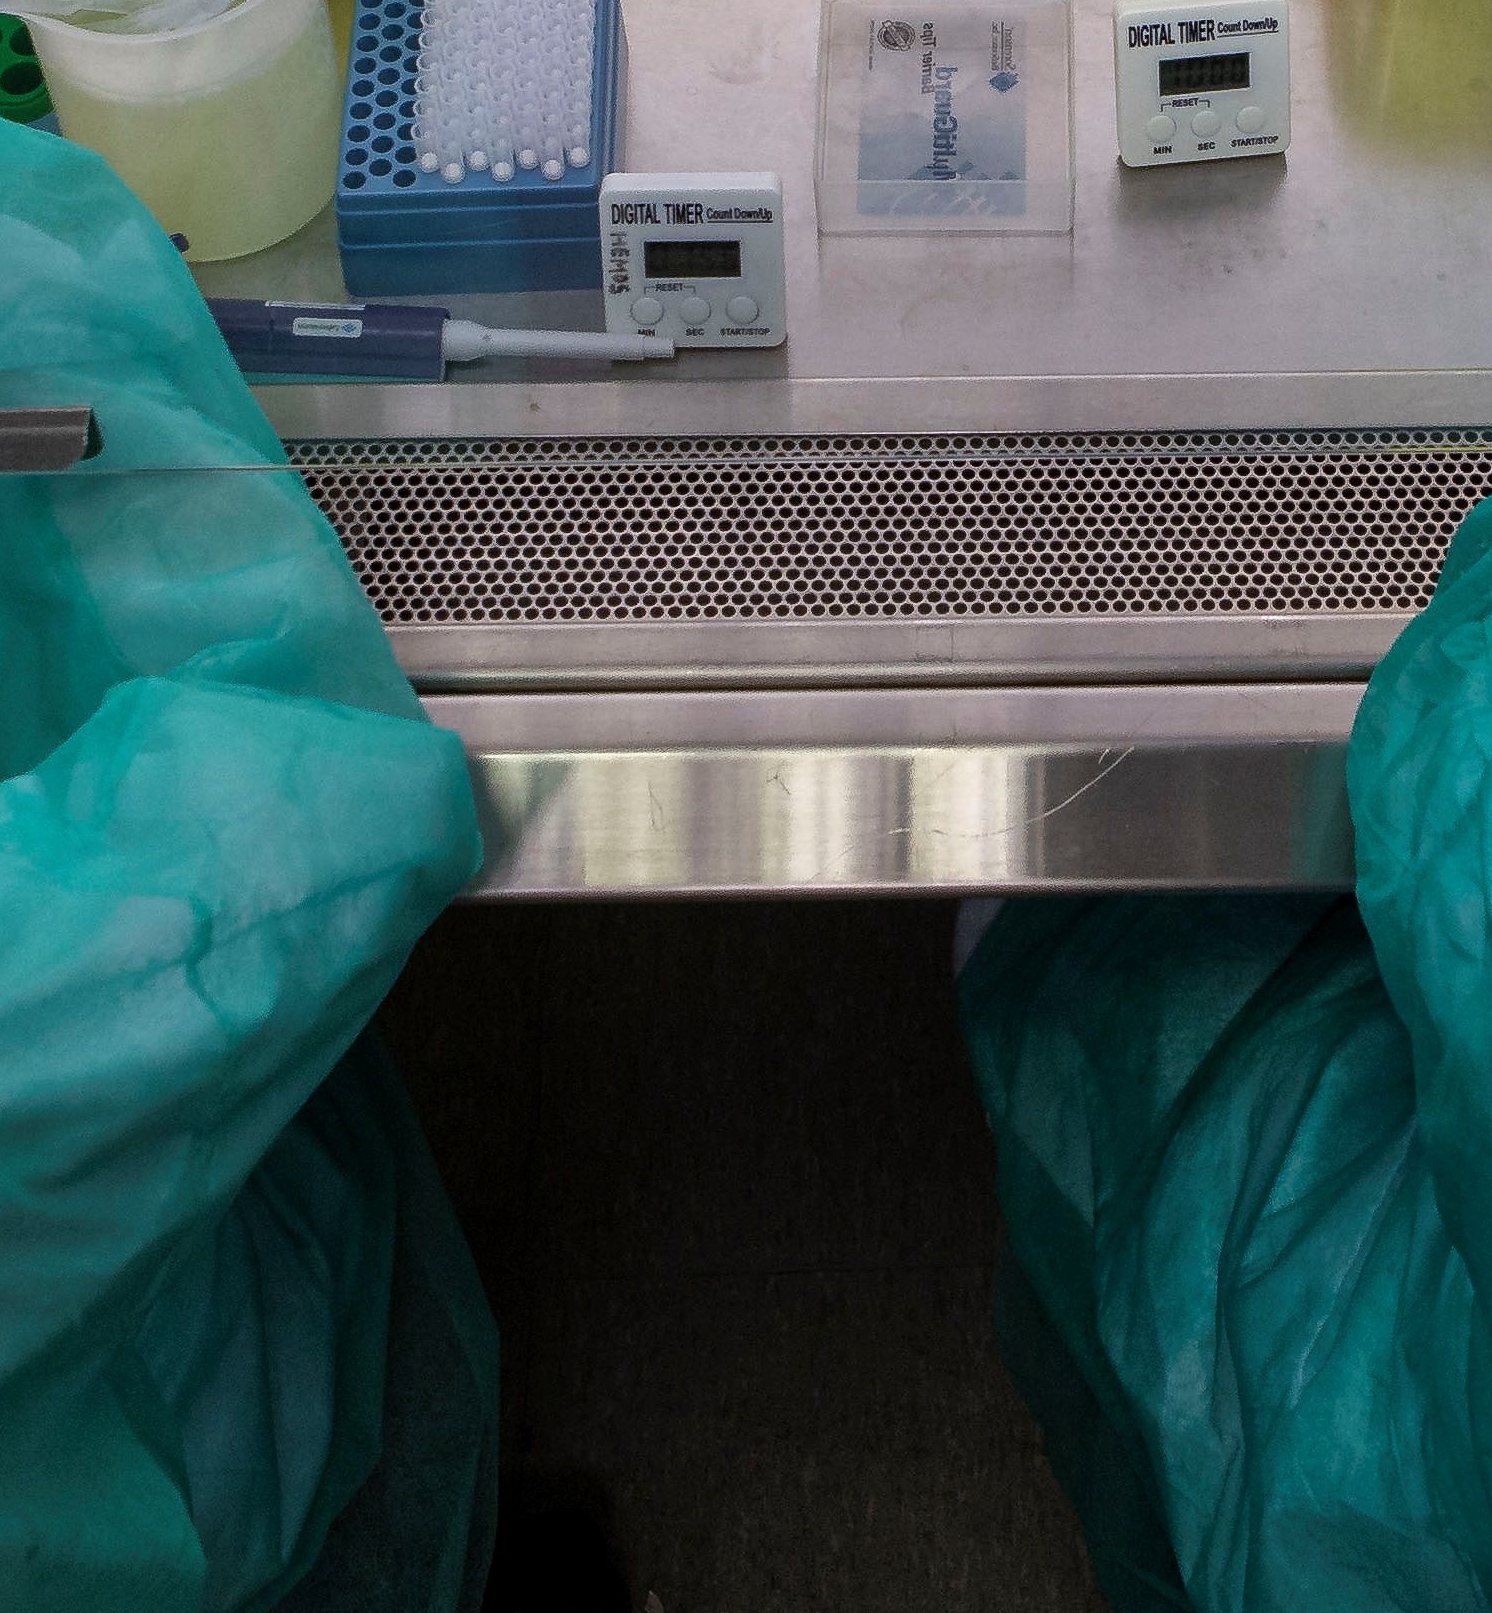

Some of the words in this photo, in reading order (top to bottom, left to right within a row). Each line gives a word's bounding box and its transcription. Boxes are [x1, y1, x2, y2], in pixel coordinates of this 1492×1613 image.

[1128, 22, 1176, 49] DIGITAL
[1178, 19, 1216, 45] TIMER
[1217, 22, 1241, 34] Count
[1243, 17, 1279, 32] Down/Up
[1171, 97, 1200, 108] RESET
[1153, 145, 1173, 155] MIN
[1197, 141, 1216, 152] SEC
[1230, 135, 1279, 148] START/STOP
[611, 203, 661, 226] DIGITAL
[663, 203, 704, 225] TIMER
[707, 207, 733, 221] Count
[734, 207, 774, 222] Down/Up
[655, 282, 685, 293] RESET
[637, 327, 656, 337] MIN
[684, 327, 706, 337] SEC
[719, 327, 771, 337] START/STOP
